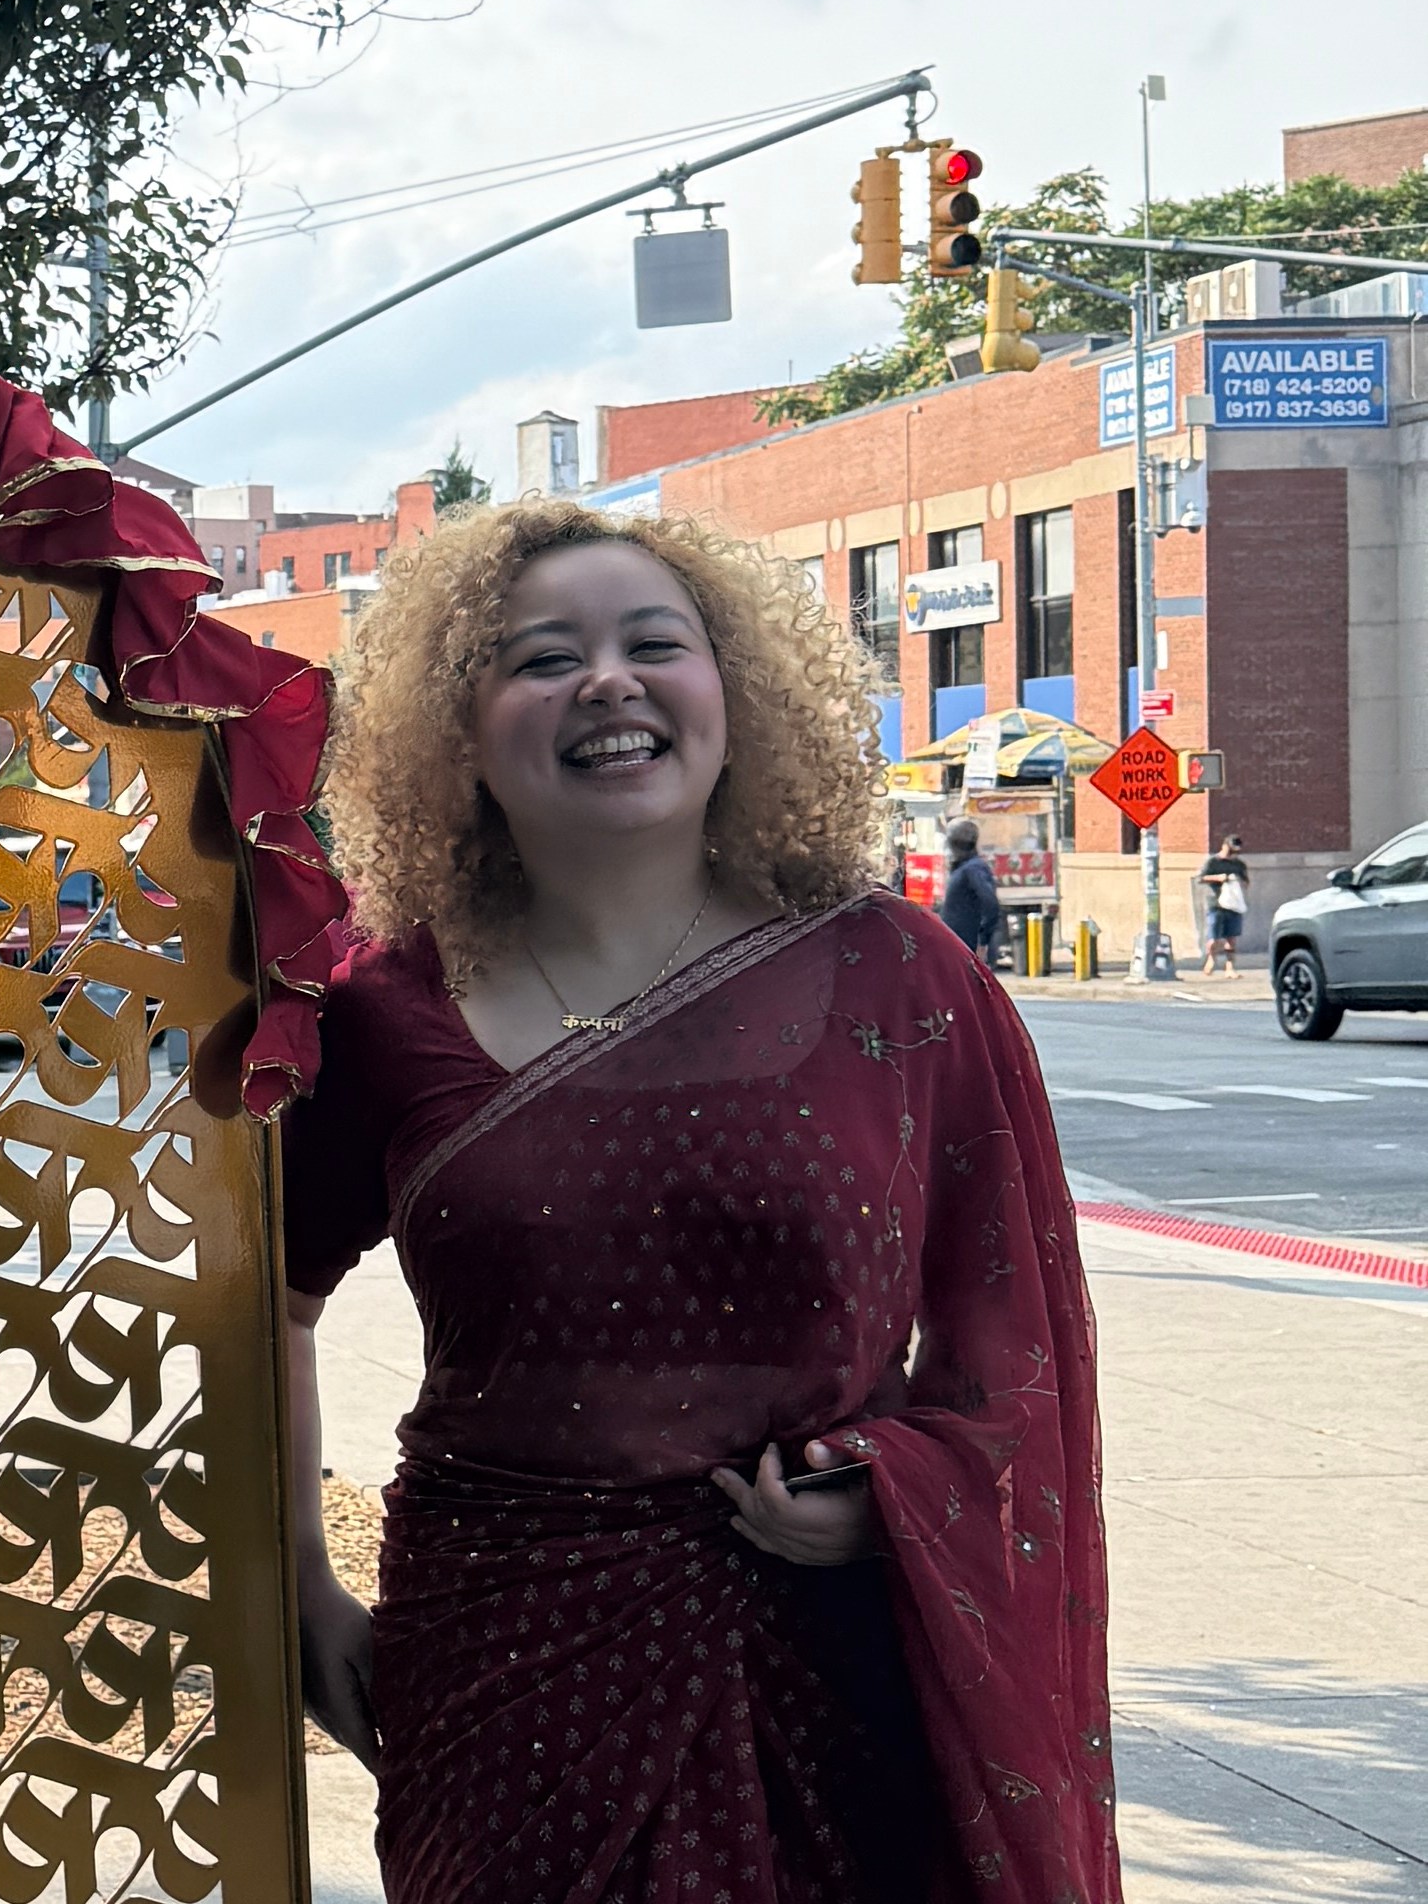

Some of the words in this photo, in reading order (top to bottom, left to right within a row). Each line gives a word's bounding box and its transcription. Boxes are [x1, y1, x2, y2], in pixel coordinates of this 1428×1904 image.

[1220, 349, 1375, 373] AVAILABLE
[1224, 378, 1271, 396] (718)
[1275, 377, 1372, 395] 424-5200
[1226, 400, 1272, 419] (917)
[1276, 399, 1371, 417] 837-3636
[1121, 751, 1166, 766] ROAD
[1122, 768, 1167, 784] WORK
[1118, 786, 1173, 801] AHEAD
